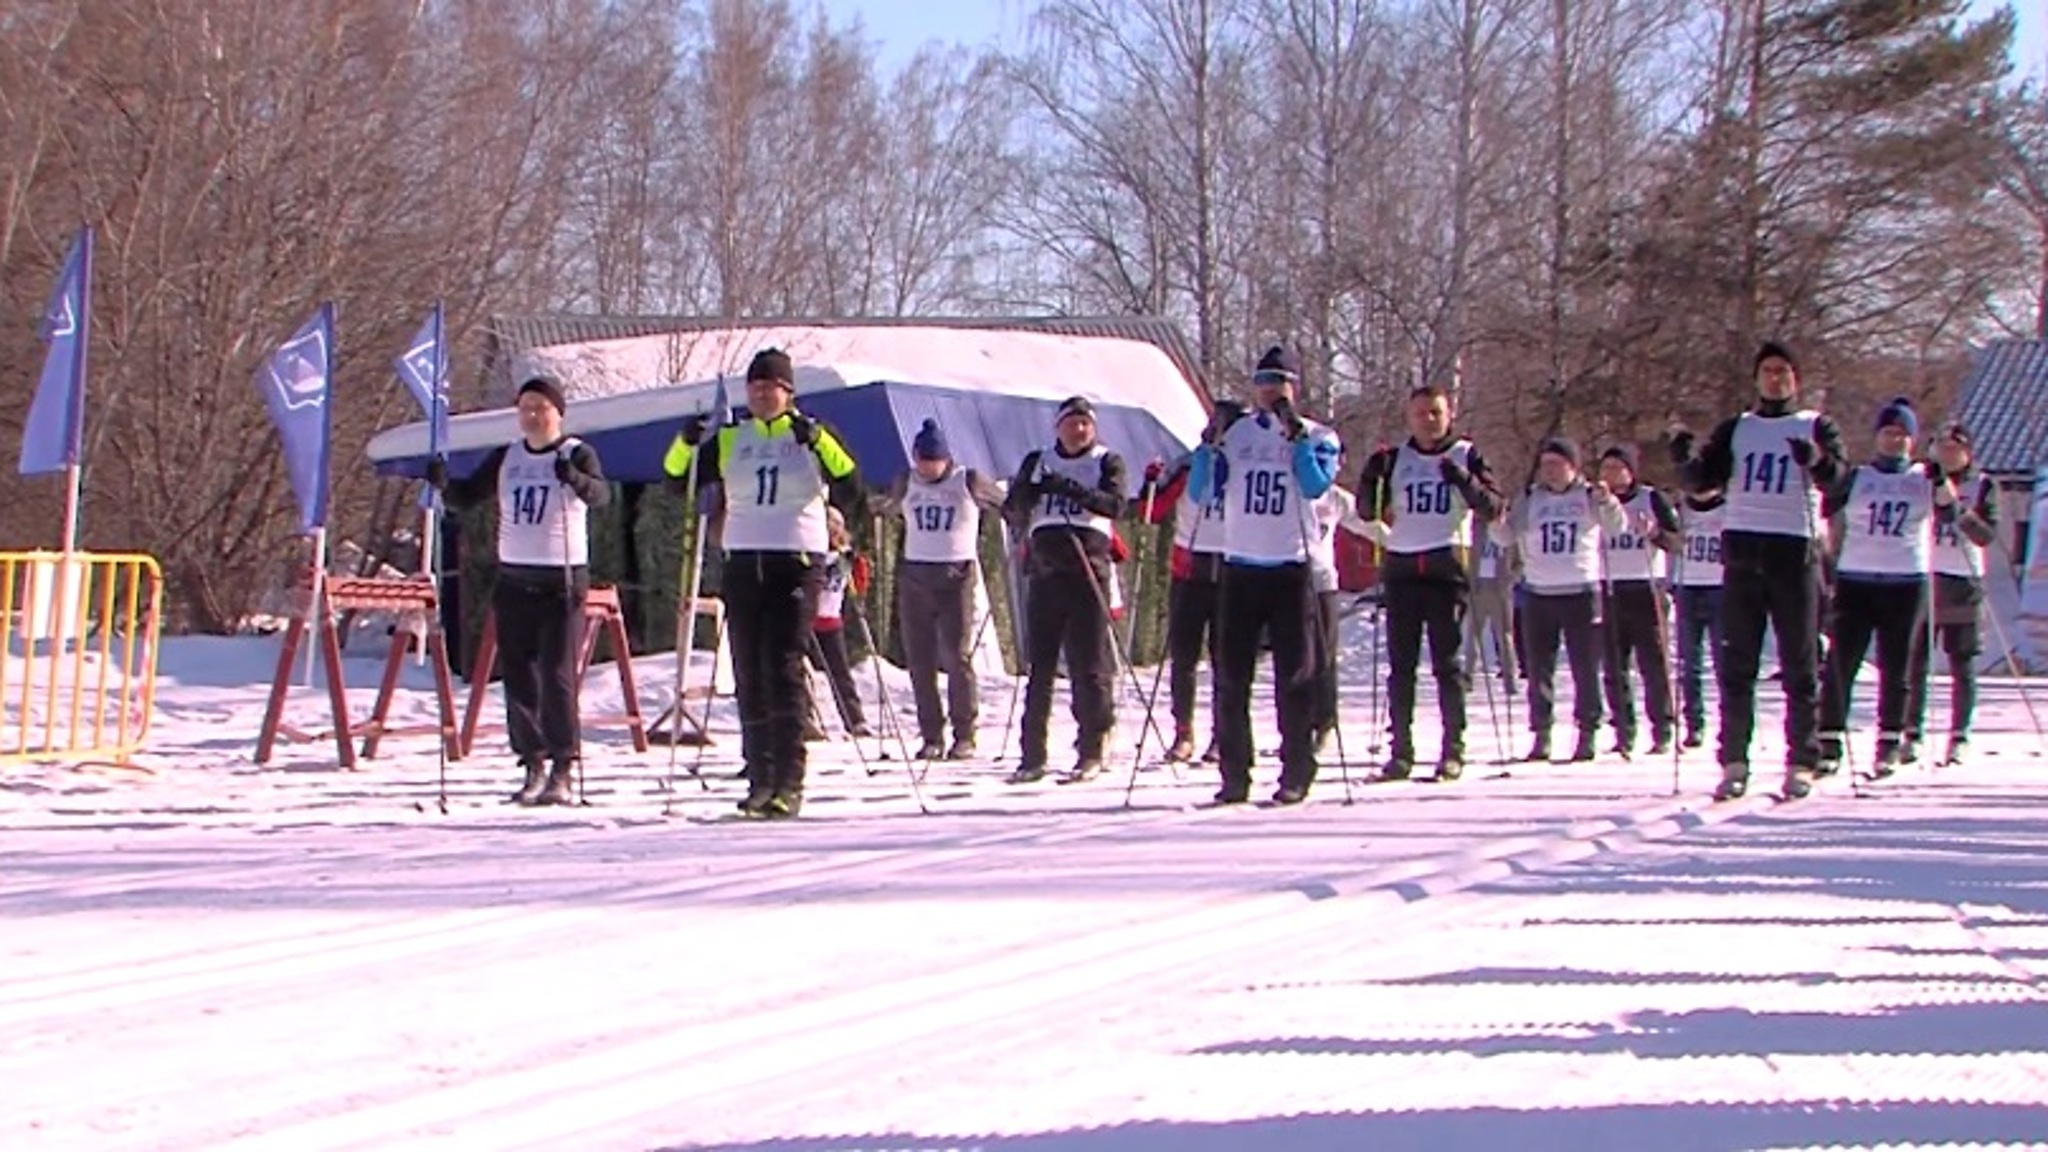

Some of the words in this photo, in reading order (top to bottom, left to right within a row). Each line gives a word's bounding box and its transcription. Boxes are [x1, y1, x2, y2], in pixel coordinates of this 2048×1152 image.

[756, 466, 778, 505] 11
[1744, 453, 1789, 493] 141
[513, 486, 548, 525] 147
[1244, 471, 1287, 514] 195
[1406, 482, 1450, 514] 150
[915, 505, 954, 531] 191
[1868, 501, 1909, 536] 142
[1541, 521, 1577, 554] 151
